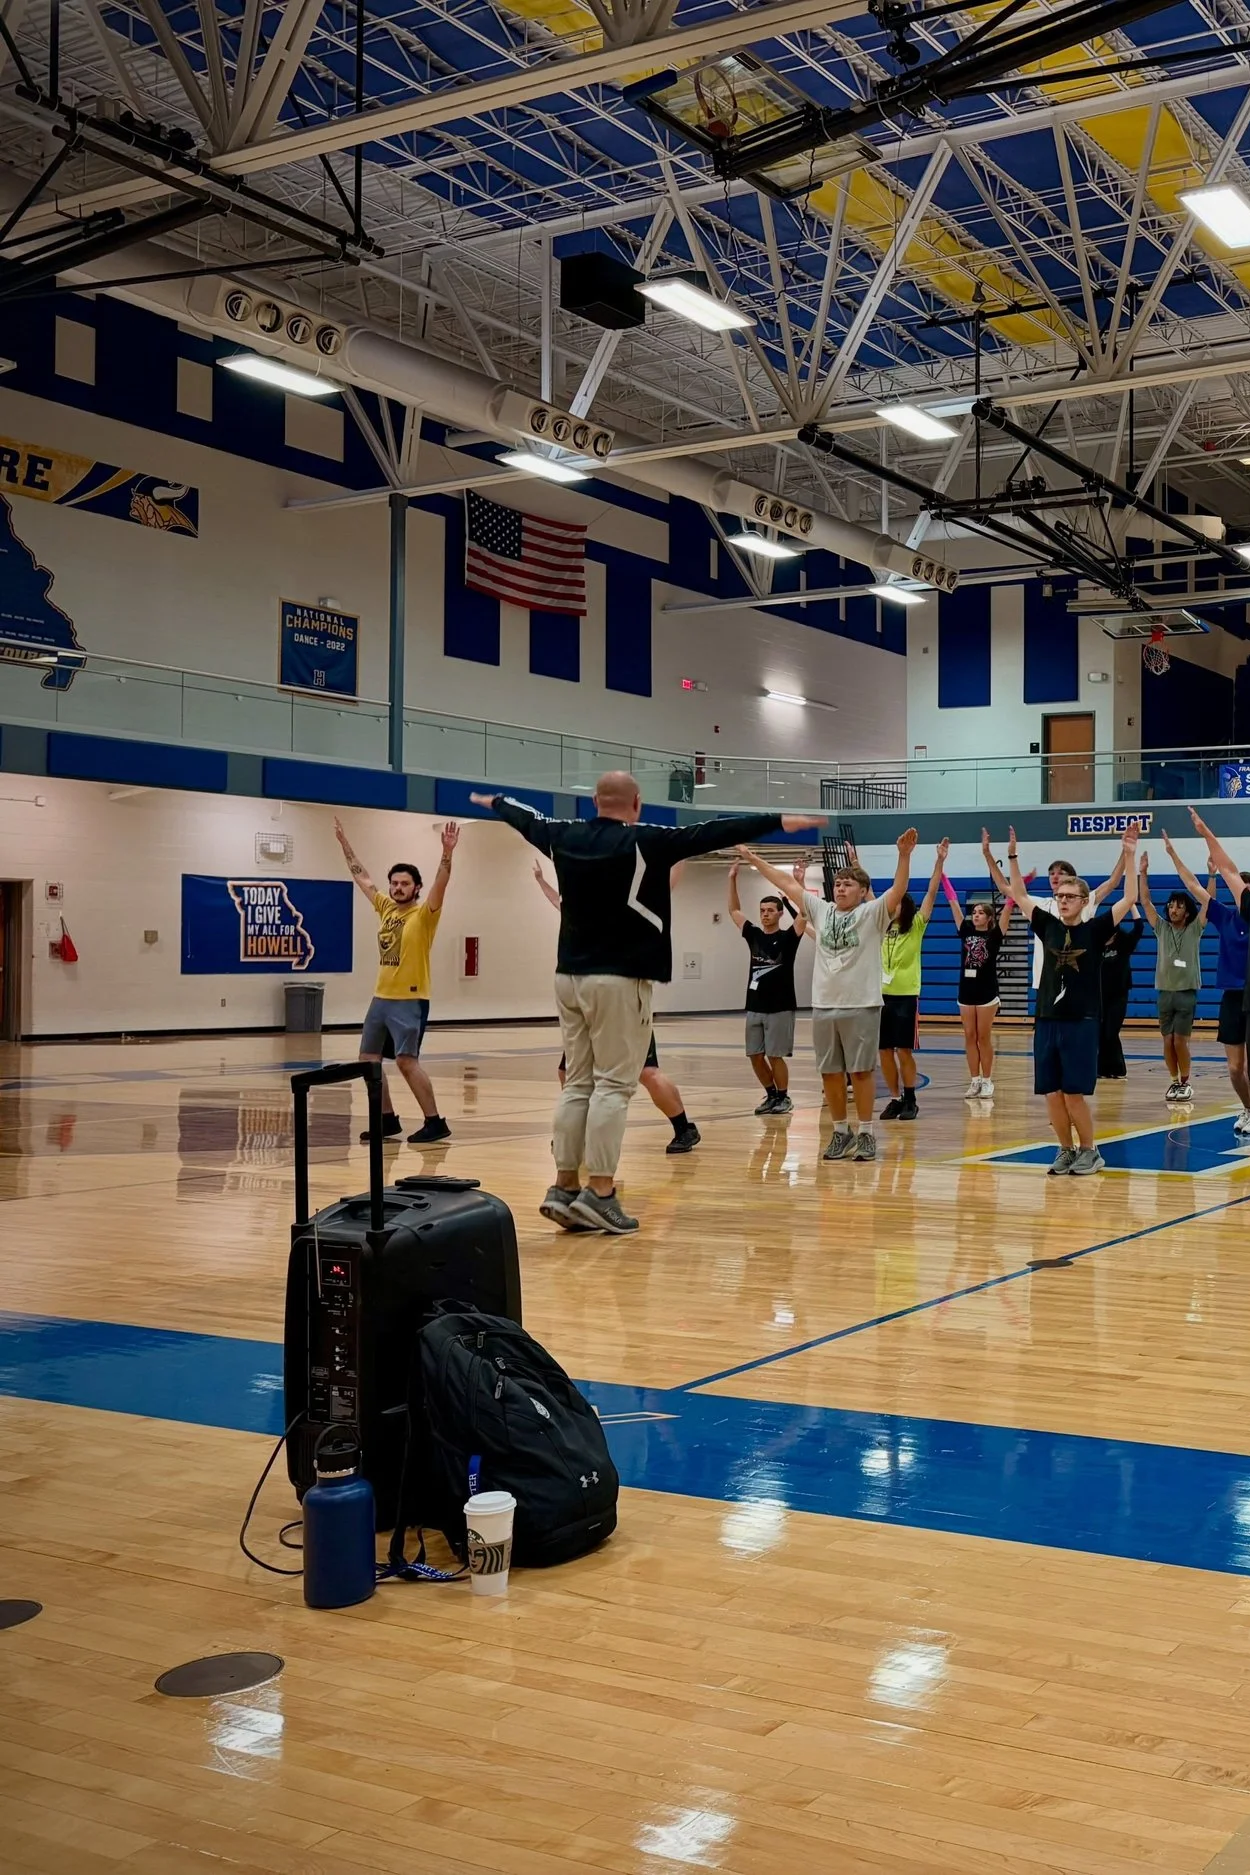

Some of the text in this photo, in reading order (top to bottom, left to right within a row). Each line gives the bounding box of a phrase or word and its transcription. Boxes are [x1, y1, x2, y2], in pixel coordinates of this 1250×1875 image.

[297, 608, 344, 625] NATIONAL
[286, 614, 354, 640] CHAMPIONS
[294, 633, 318, 646] DANCE
[326, 640, 346, 652] 2022
[243, 887, 281, 906] TODAY
[247, 906, 281, 924] I GIVE
[247, 925, 295, 936] MY ALL FOR
[247, 936, 304, 956] HOWELL
